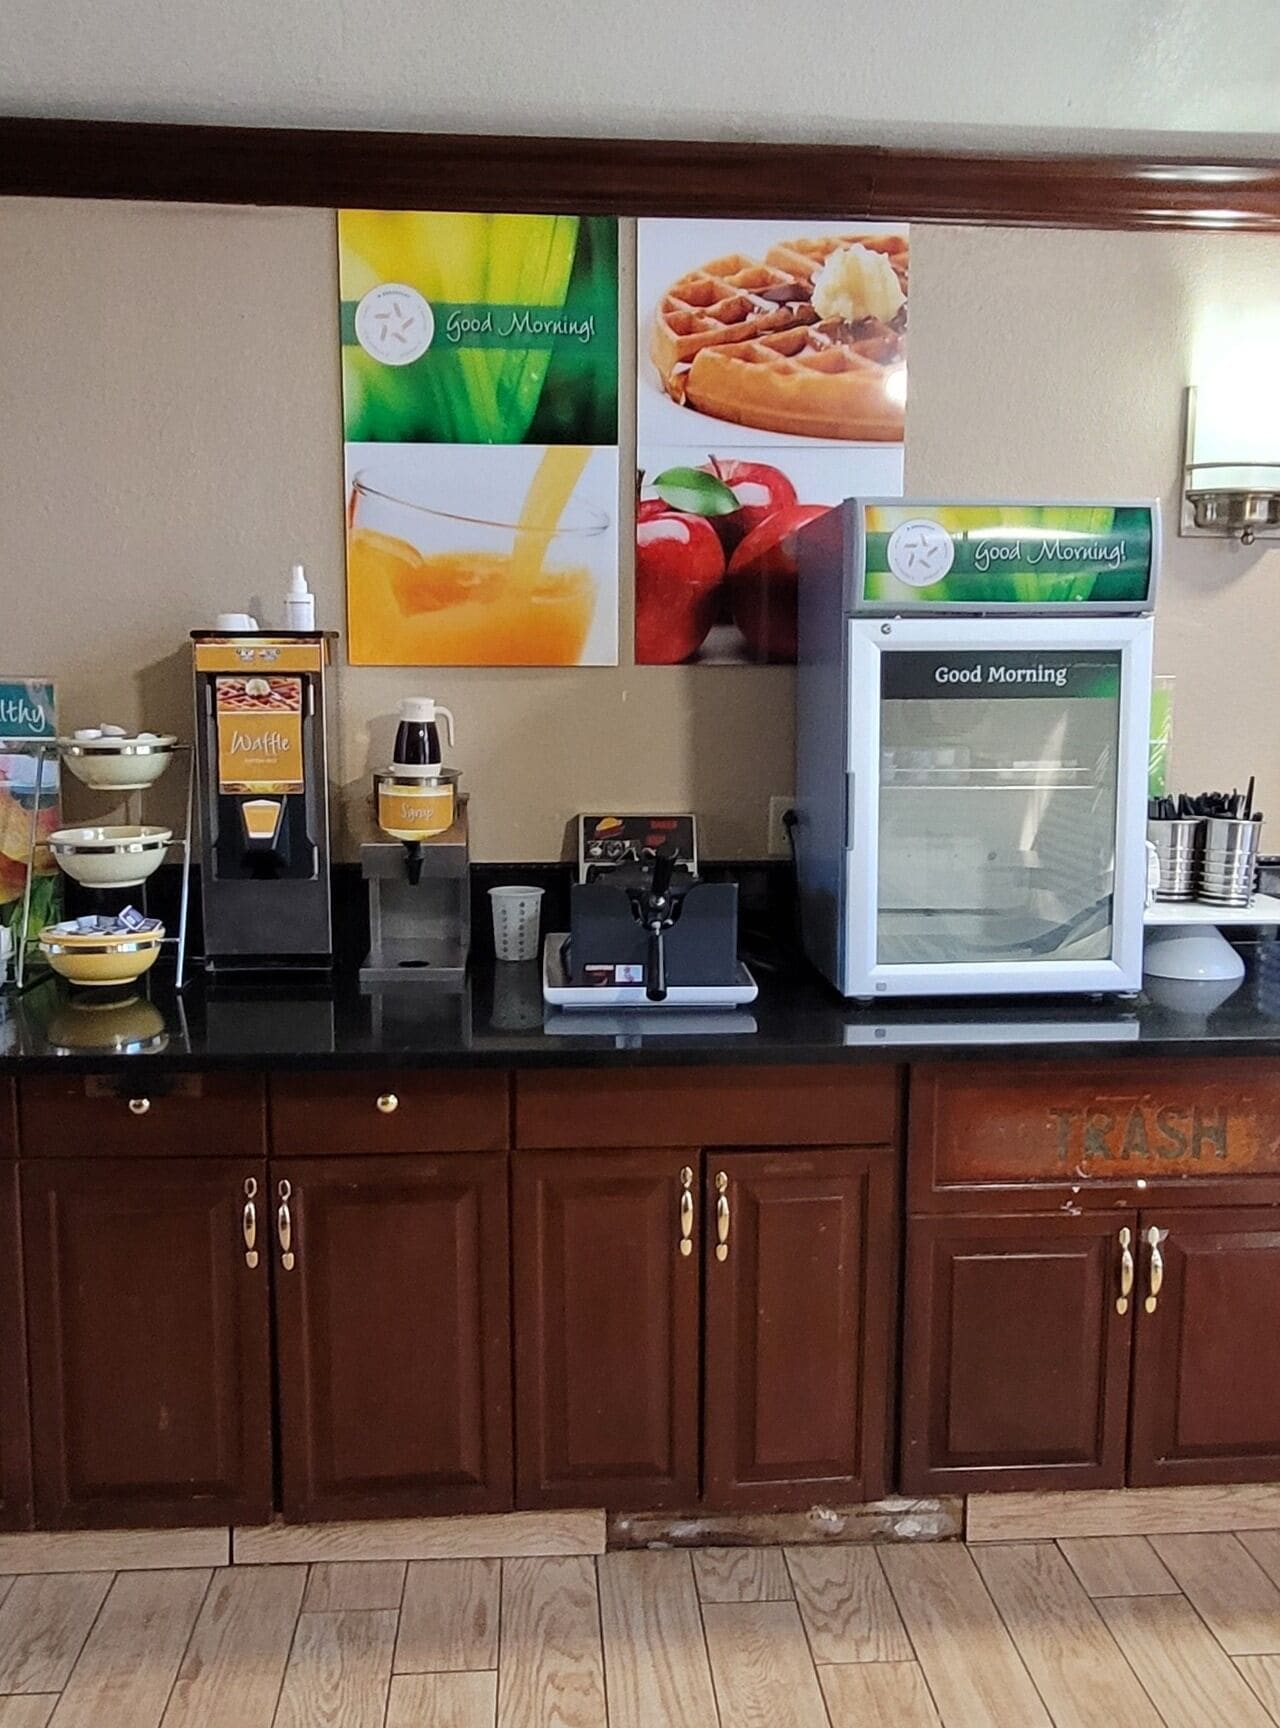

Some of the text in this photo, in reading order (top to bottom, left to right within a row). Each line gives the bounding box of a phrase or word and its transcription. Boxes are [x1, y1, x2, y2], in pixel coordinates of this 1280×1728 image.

[446, 310, 596, 343] Good Morning!
[974, 538, 1126, 571] Good Morning!
[934, 664, 1068, 686] Good Morning
[230, 731, 290, 755] Waffle
[400, 802, 434, 822] Syrup
[1047, 1105, 1228, 1161] TRASH
